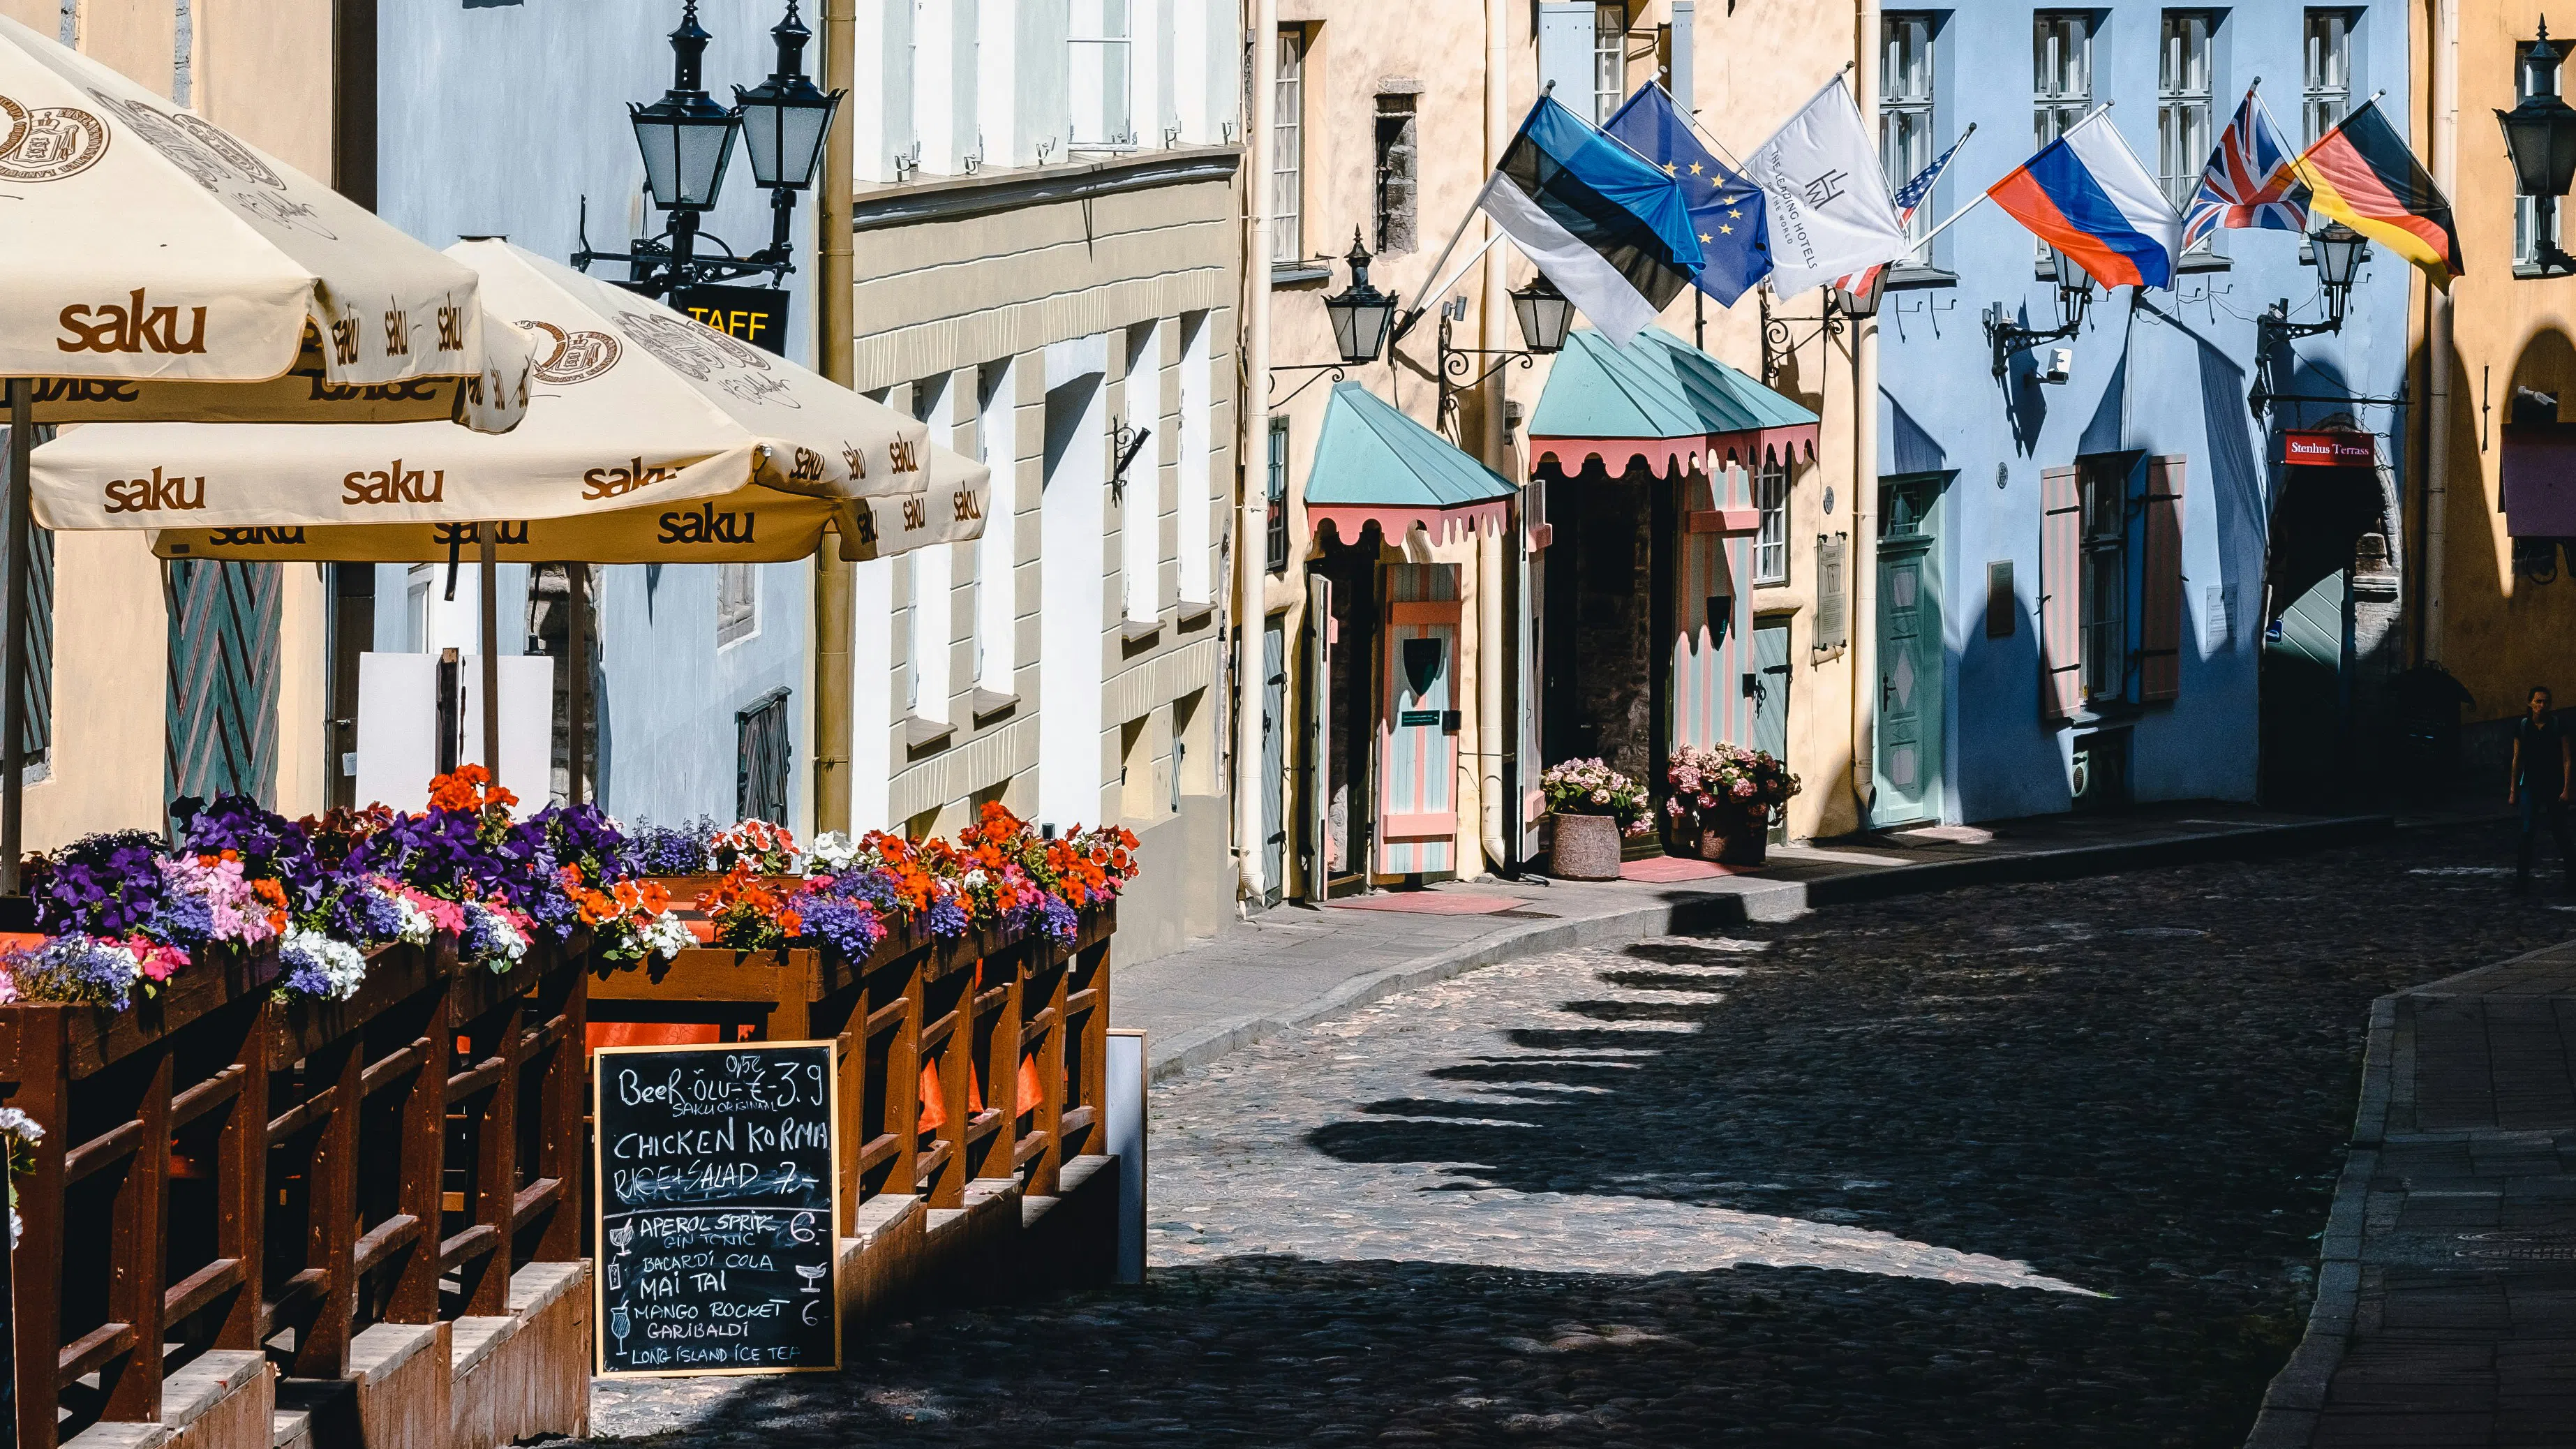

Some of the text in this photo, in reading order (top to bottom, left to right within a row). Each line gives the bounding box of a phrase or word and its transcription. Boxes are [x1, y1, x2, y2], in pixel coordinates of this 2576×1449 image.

[1771, 149, 1780, 171] THE
[1775, 172, 1799, 220] LEADING
[1779, 214, 1793, 244] WORLD
[1794, 223, 1817, 269] HOTELS
[57, 287, 207, 354] saku
[332, 303, 359, 366] saku
[385, 293, 408, 357] saku
[438, 291, 463, 352] saku
[789, 447, 825, 480] saku
[842, 440, 865, 480] saku
[890, 431, 918, 474] saku
[2291, 442, 2369, 455] Stenhus Terrass
[104, 466, 205, 513] saku
[341, 458, 444, 506] saku
[953, 480, 981, 521] saku
[657, 501, 755, 544] saku
[903, 493, 925, 531] saku
[673, 1102, 715, 1117] SAKU
[613, 1117, 829, 1159] CHICKEN KORMA
[640, 1216, 711, 1238] APEROL
[664, 1232, 756, 1249] GIN TONIC
[643, 1250, 774, 1273] BACARDI COLA
[640, 1270, 727, 1300] MAI TAI
[634, 1304, 699, 1319] MANGO
[709, 1299, 791, 1317] ROCKET
[648, 1321, 748, 1339] GARIBALDI
[632, 1348, 672, 1365] LONG
[676, 1344, 728, 1362] ISLAND
[735, 1344, 761, 1361] ICE
